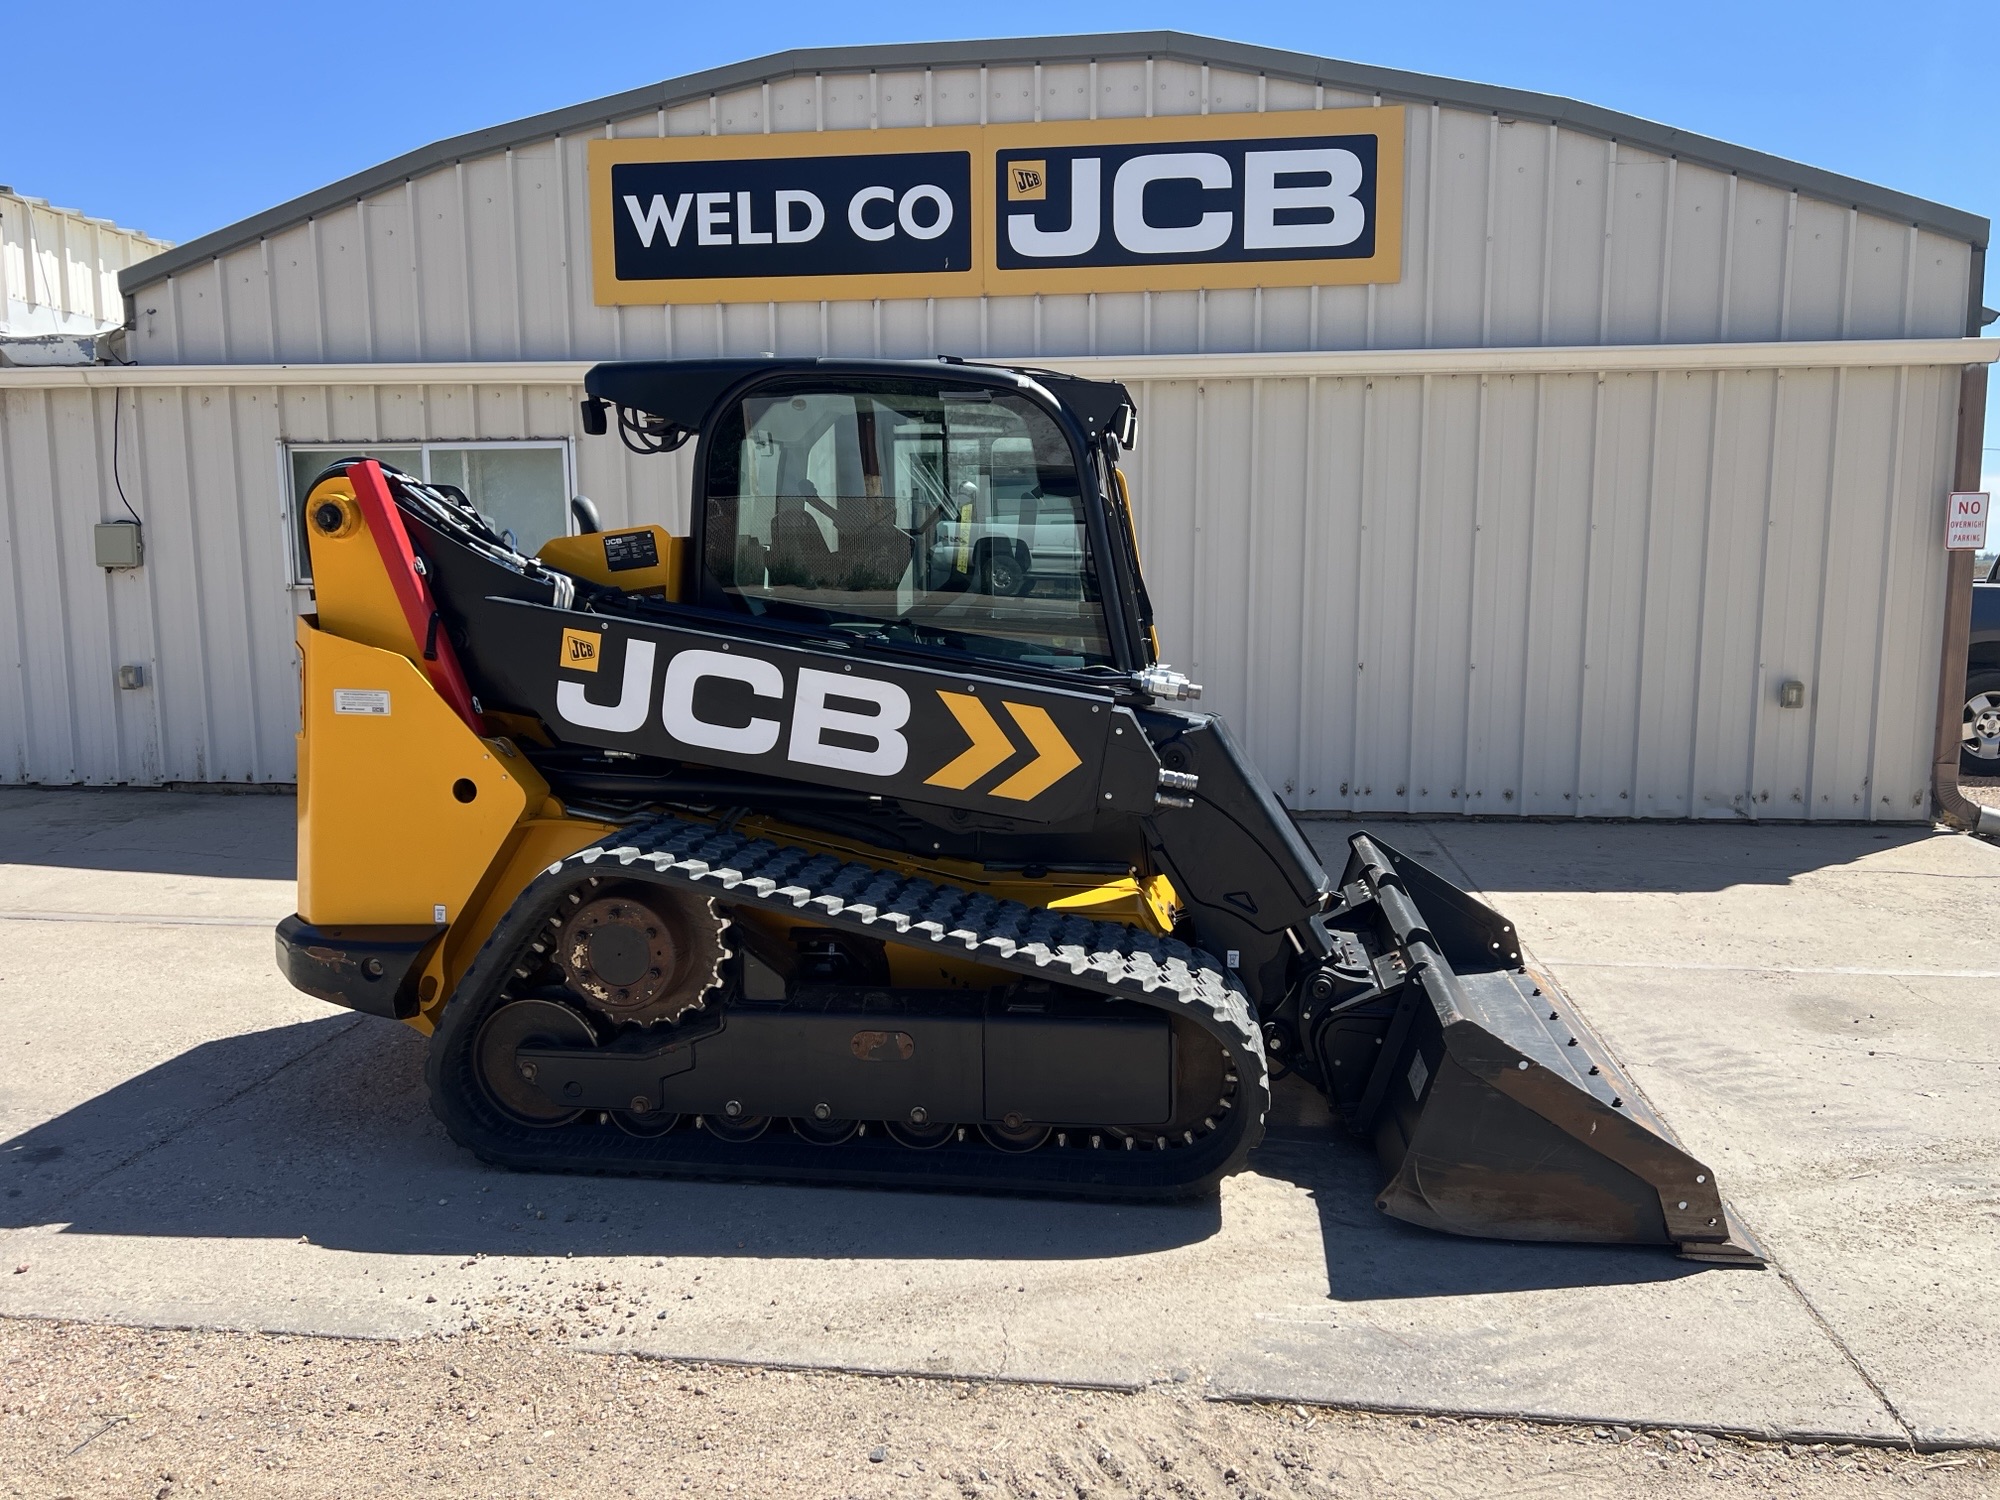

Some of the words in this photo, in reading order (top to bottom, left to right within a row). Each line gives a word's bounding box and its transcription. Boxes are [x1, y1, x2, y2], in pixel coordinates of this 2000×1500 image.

[1018, 171, 1040, 190] JCB
[1008, 149, 1365, 257] JCB
[623, 189, 825, 247] WELD
[848, 184, 953, 241] CO
[1958, 501, 1981, 514] NO
[1950, 520, 1984, 529] OVERNIGHT
[1953, 534, 1980, 542] PARKING
[572, 639, 593, 658] JCB
[556, 638, 911, 776] JCB
